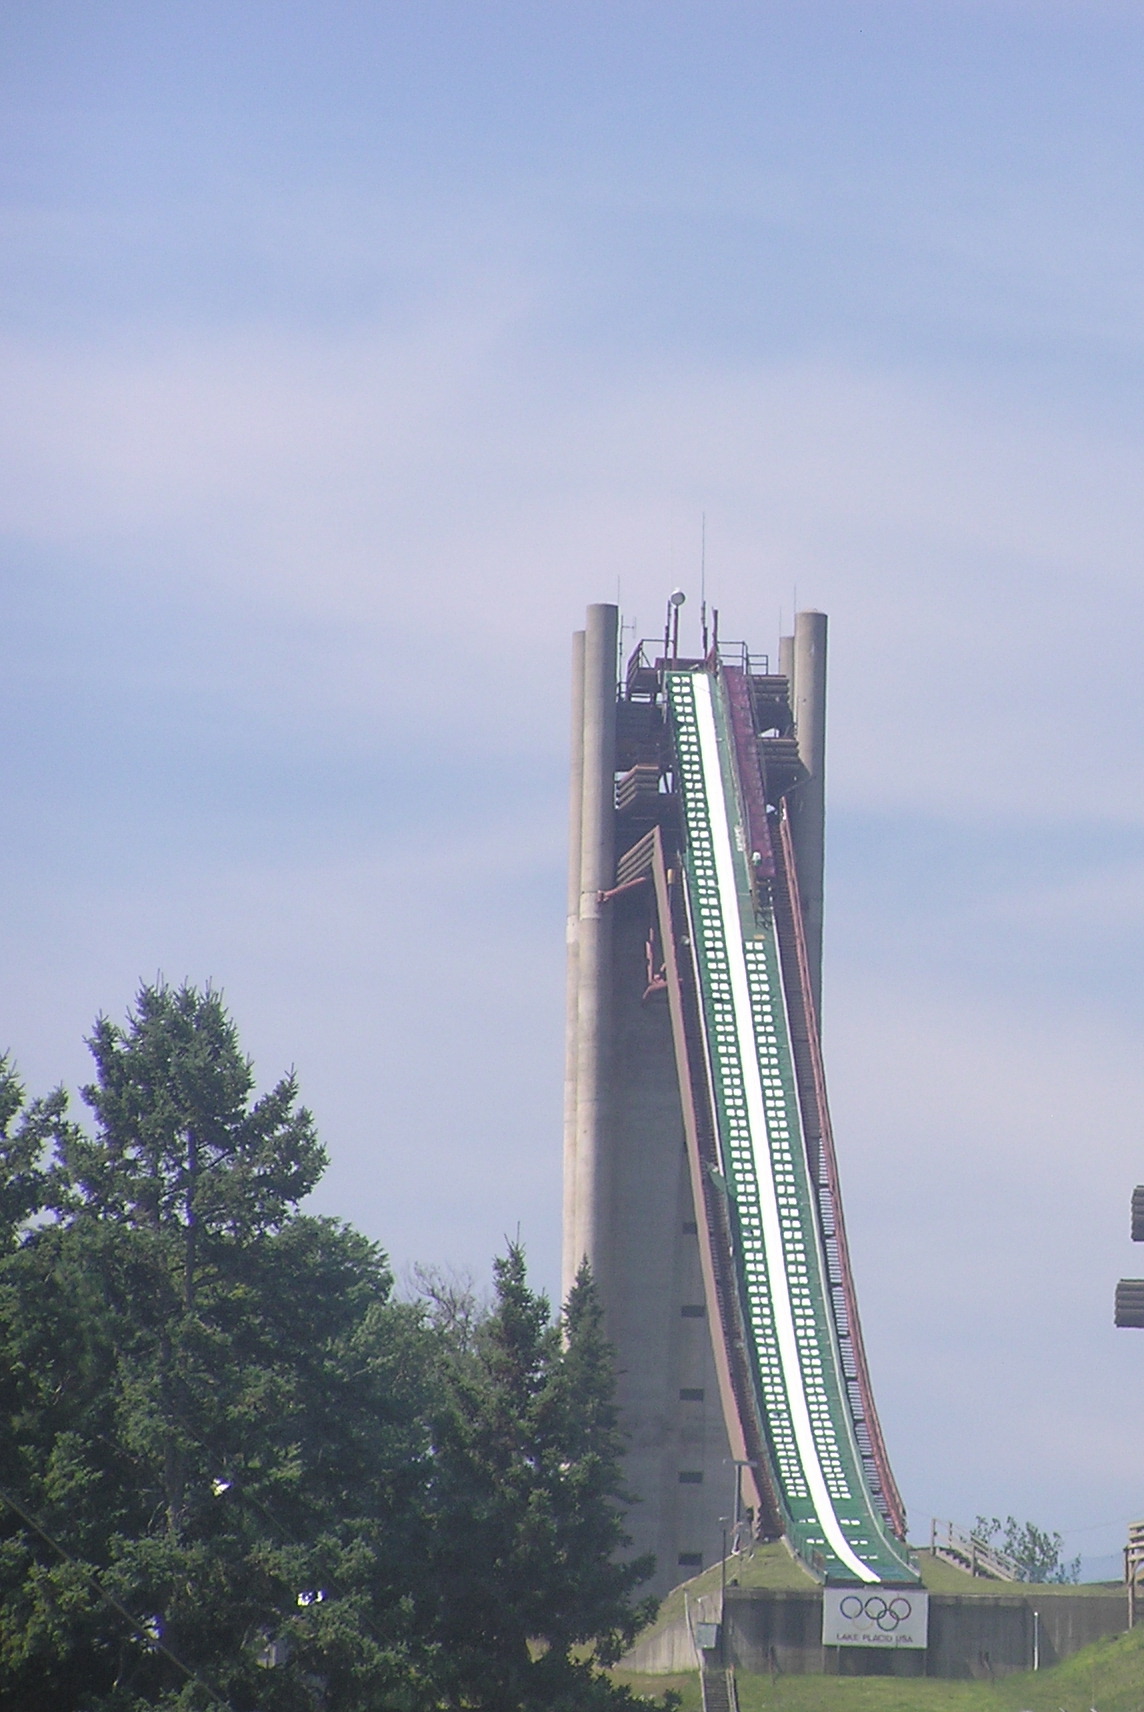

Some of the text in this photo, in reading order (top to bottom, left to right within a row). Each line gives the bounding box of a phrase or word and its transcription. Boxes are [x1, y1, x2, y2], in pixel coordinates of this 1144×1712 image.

[836, 1633, 913, 1643] LAKE PLACID USA
